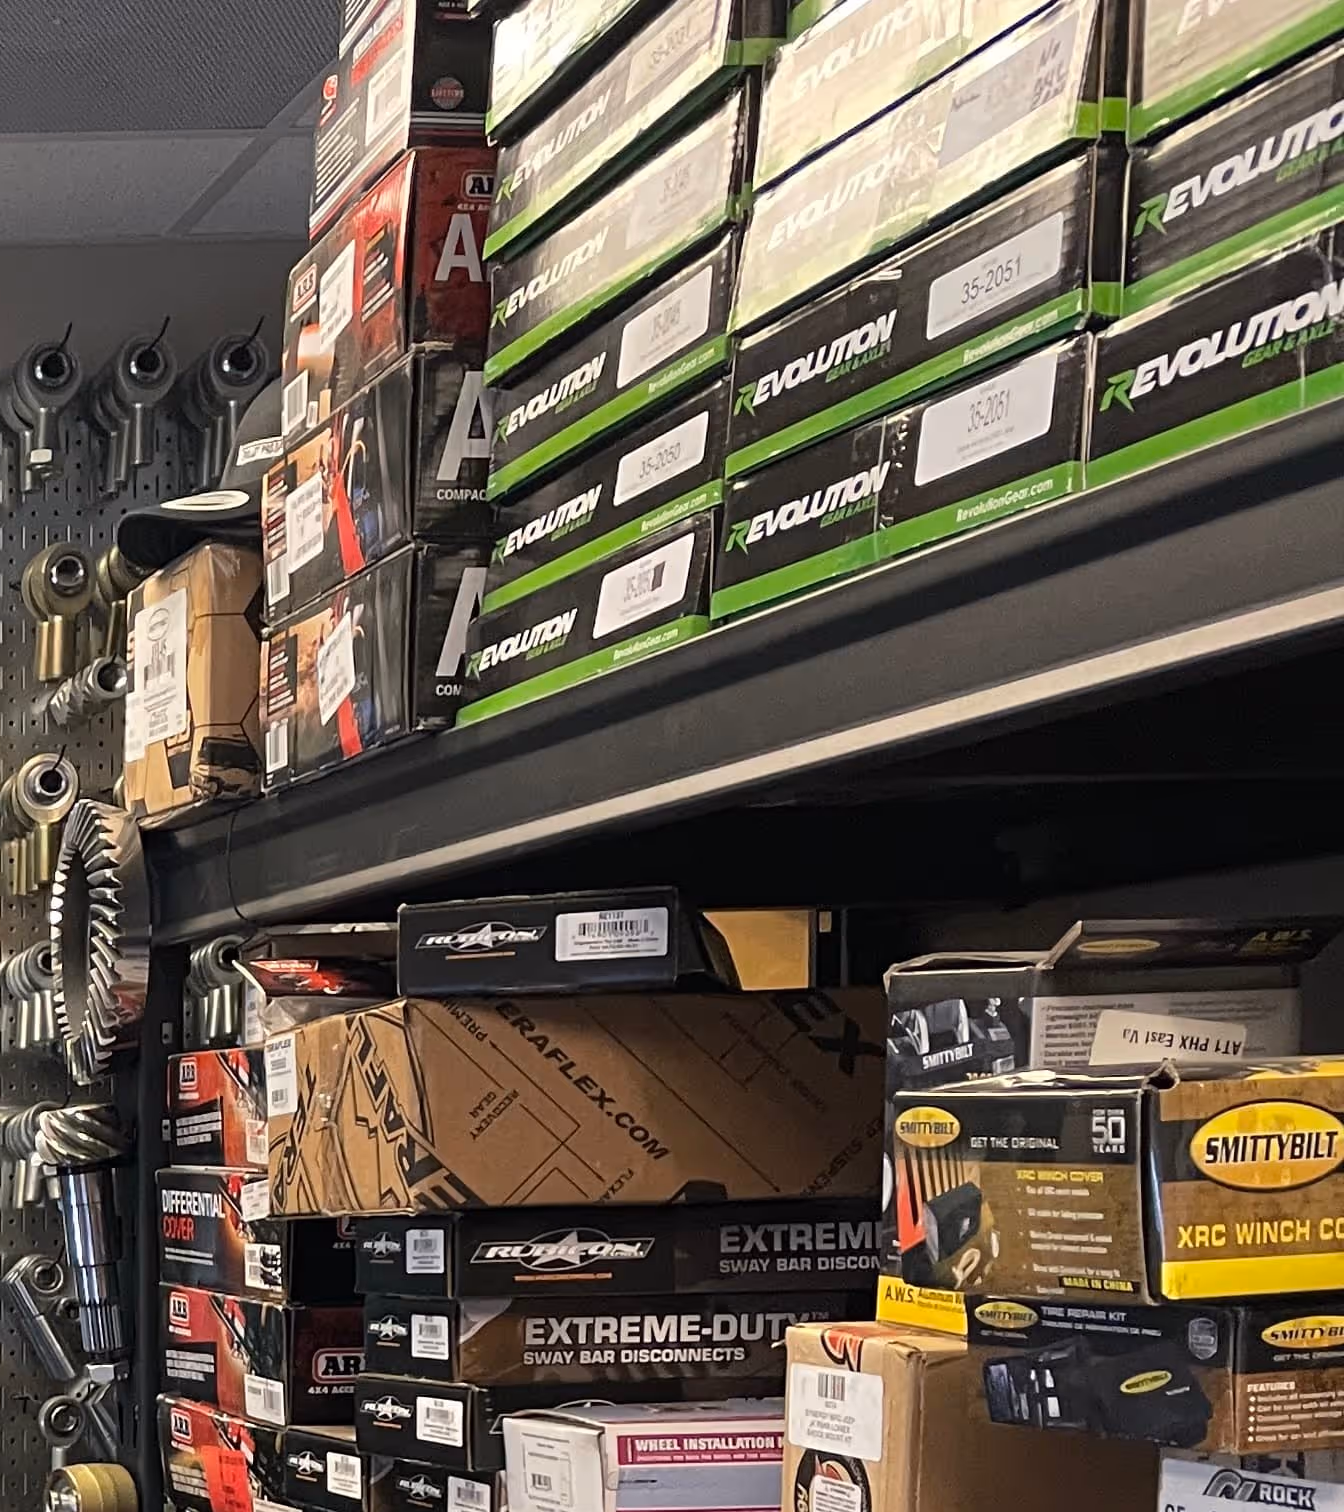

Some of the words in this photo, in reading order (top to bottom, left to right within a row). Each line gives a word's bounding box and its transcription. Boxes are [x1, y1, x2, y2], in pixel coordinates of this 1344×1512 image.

[496, 88, 610, 203] REVOLUTION
[491, 226, 609, 329] REVOLUTION
[961, 255, 1022, 304] 35-2051
[1100, 279, 1344, 413] REVOLUTION
[733, 310, 897, 417] REVOLUTION
[493, 352, 605, 445] REVOLUTION
[967, 388, 1011, 434] 35-2051
[639, 441, 682, 480] 35-2050
[726, 461, 890, 555] REVOLUTION
[956, 478, 1054, 523] RevolutionGear.com
[492, 484, 602, 565] REVOLUTION
[465, 608, 578, 680] REVOLUTION
[1144, 1031, 1174, 1046] East
[1178, 1036, 1210, 1054] PHX
[1212, 1040, 1242, 1056] AT1
[922, 1043, 974, 1069] SMITTYBILT
[900, 1119, 955, 1135] SMITTYBILT
[1092, 1115, 1126, 1143] 50
[971, 1136, 990, 1149] GET
[991, 1137, 1009, 1149] THE
[1012, 1137, 1060, 1149] ORIGINAL
[1205, 1130, 1339, 1164] SMITTYBILT
[161, 1189, 225, 1219] DIFFERENTIAL
[163, 1214, 196, 1241] COVER
[1178, 1223, 1226, 1249] XRC
[1235, 1218, 1311, 1246] WINCH
[720, 1258, 770, 1273] SWAY
[776, 1257, 811, 1272] BAR
[1104, 1280, 1133, 1291] CHINA
[980, 1308, 1036, 1322] SMITTYBILT
[1041, 1306, 1065, 1317] TIRE
[1067, 1308, 1106, 1320] REPAIR
[1109, 1311, 1127, 1321] KIT
[524, 1313, 809, 1346] EXTREME-DUTY
[523, 1348, 574, 1366] SWAY
[579, 1348, 614, 1365] BAR
[620, 1346, 746, 1364] DISCONNECTS
[308, 1386, 329, 1394] 4X4
[1248, 1382, 1296, 1393] FEATURES
[635, 1436, 680, 1453] WHEEL
[682, 1434, 774, 1451] INSTALLATION
[1259, 1483, 1314, 1508] ROCK
